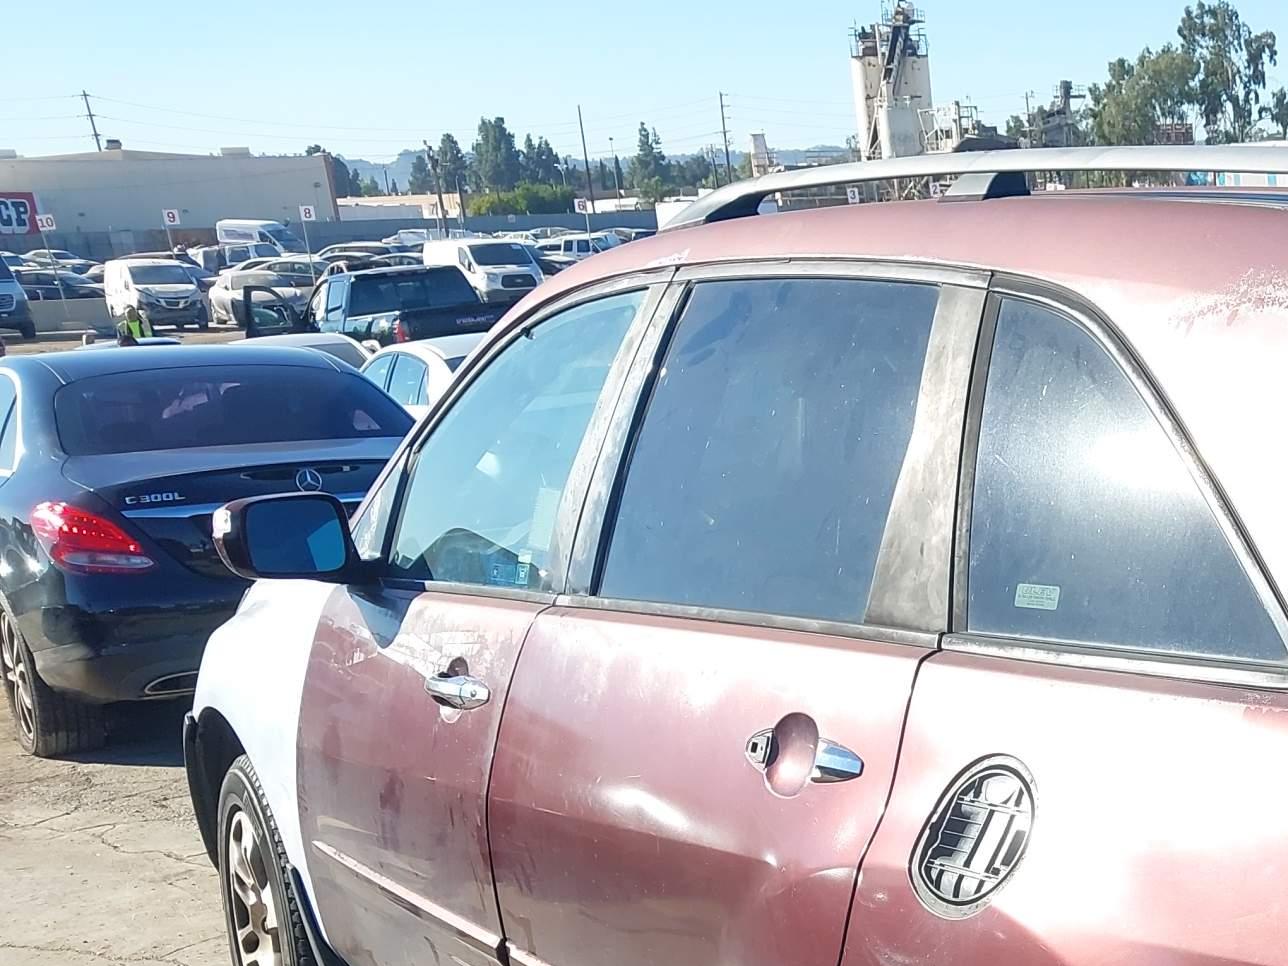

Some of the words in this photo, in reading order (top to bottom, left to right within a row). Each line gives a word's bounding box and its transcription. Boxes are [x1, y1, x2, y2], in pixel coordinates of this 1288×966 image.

[849, 189, 856, 200] 3
[931, 184, 938, 194] 2
[577, 200, 585, 211] 6
[166, 211, 176, 223] 9
[303, 207, 312, 219] 8
[38, 217, 55, 228] 10
